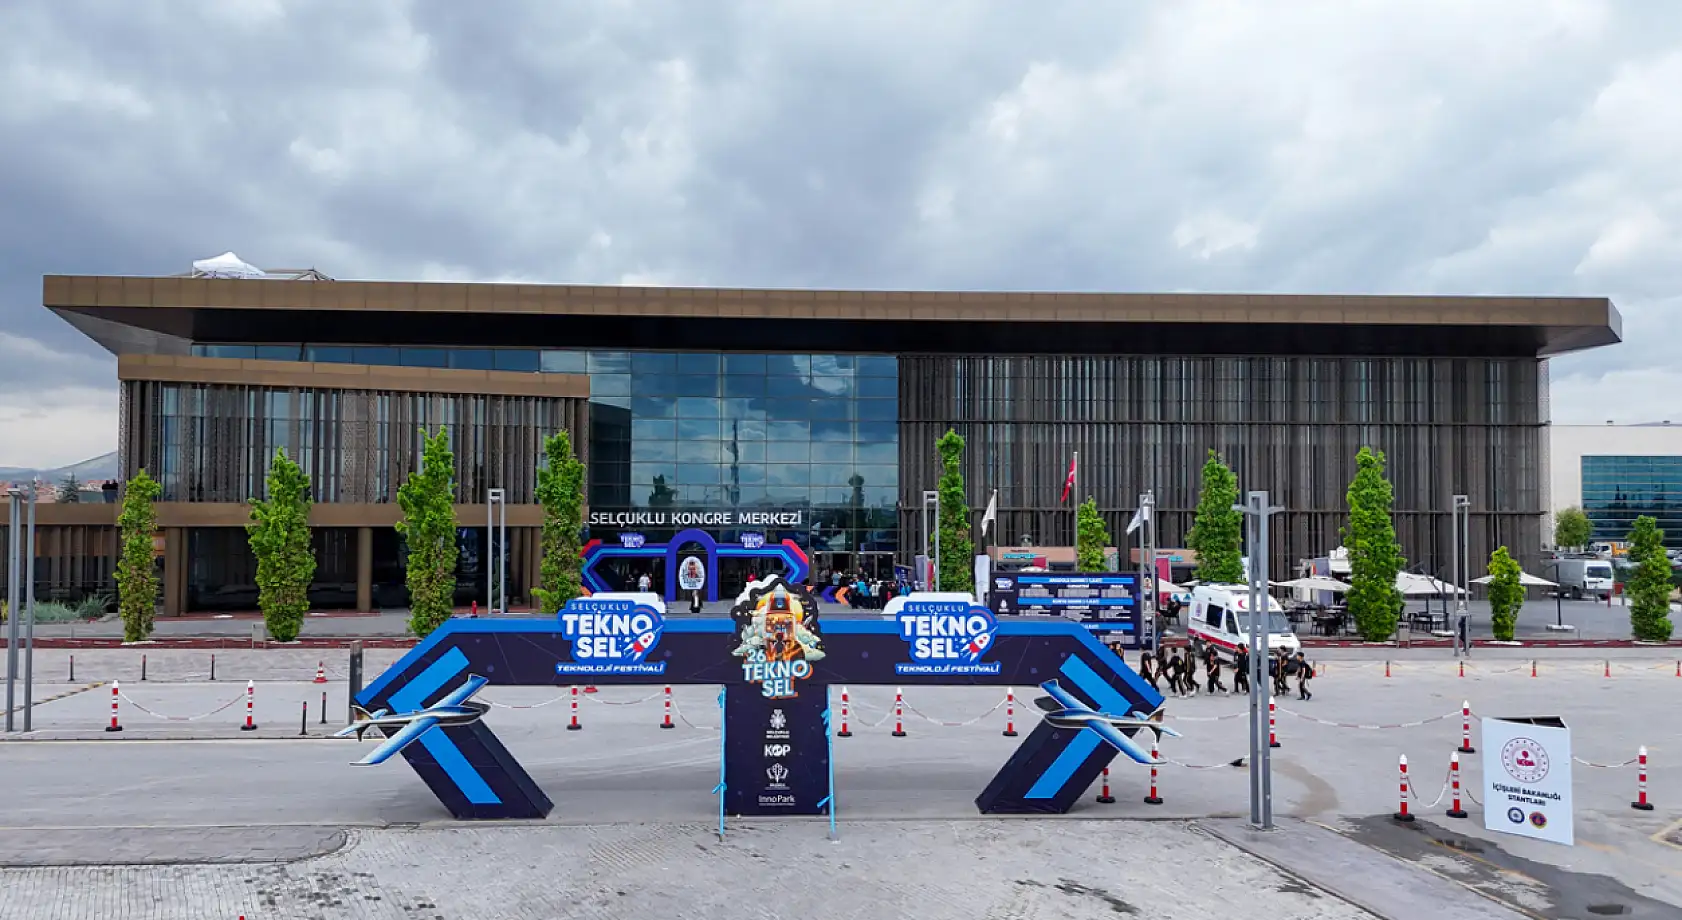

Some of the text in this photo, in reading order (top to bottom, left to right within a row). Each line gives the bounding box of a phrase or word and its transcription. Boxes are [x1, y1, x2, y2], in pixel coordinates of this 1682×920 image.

[590, 510, 802, 528] SELÇUKLU KONGRE MERKEZİ
[570, 602, 629, 612] SELÇUKLU
[908, 604, 964, 614] SELÇUKLU
[562, 612, 653, 636] TEKNO
[900, 614, 988, 637] TEKNO
[576, 636, 622, 658] SEL
[747, 648, 766, 662] 26
[915, 637, 960, 659] SEL
[557, 662, 664, 673] TEKNOLOJİ FESTİVALİ
[742, 660, 809, 681] TEKNO
[898, 663, 999, 673] TEKNOLOJİ FESTİVALİ
[762, 679, 795, 697] SEL
[764, 743, 791, 757] KOP
